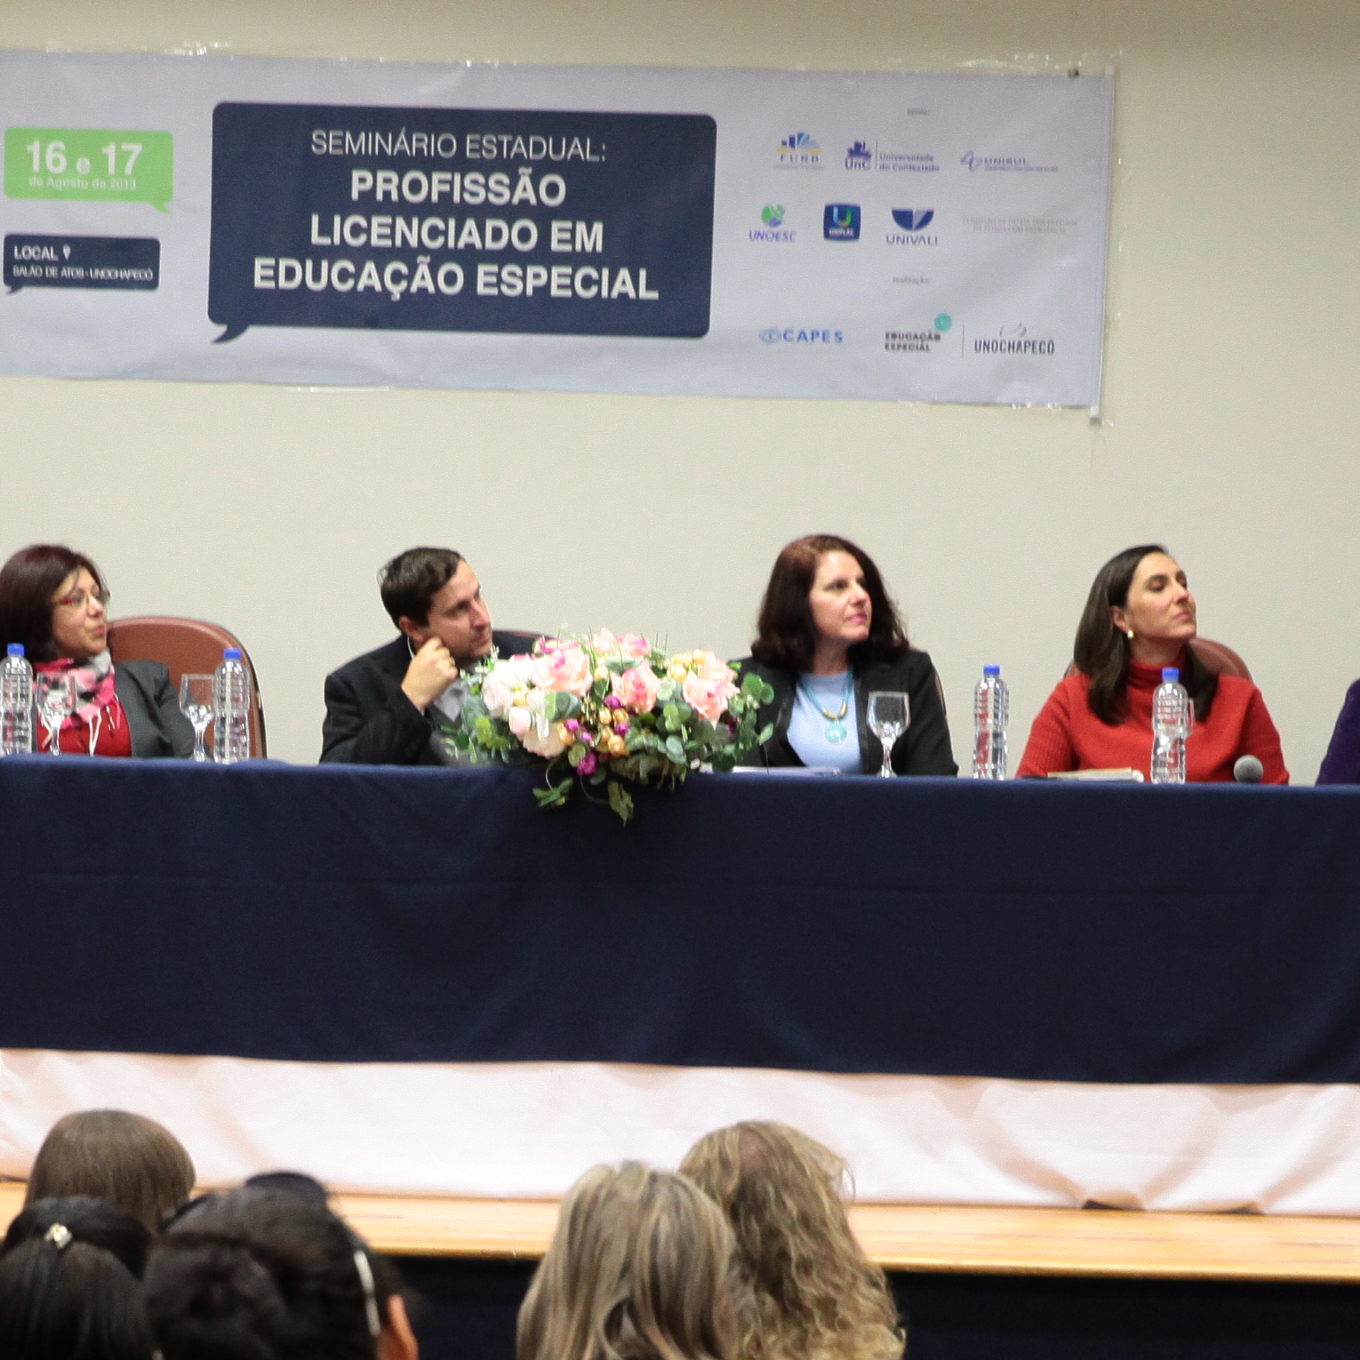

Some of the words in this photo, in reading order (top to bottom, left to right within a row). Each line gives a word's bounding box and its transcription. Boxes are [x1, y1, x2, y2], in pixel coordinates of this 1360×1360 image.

[311, 126, 457, 159] SEMINÁRIO
[466, 133, 606, 162] ESTADUAL:
[26, 139, 67, 174] 16
[76, 157, 90, 175] e
[101, 142, 143, 176] 17
[28, 176, 44, 188] de
[47, 176, 89, 190] Agosto
[91, 178, 107, 189] de
[109, 178, 137, 191] 2013
[351, 166, 566, 207] PROFISSÃO
[310, 213, 538, 252] LICENCIADO
[550, 219, 603, 253] EM
[748, 229, 797, 243] UNOESC
[885, 234, 939, 247] UNIVALI
[13, 244, 59, 261] LOCAL
[45, 265, 58, 280] DE
[254, 254, 465, 302] EDUCAÇÃO
[476, 263, 659, 301] ESPECIAL
[783, 328, 845, 344] CAPES
[884, 342, 931, 353] ESPECIAL
[973, 337, 1056, 356] UNOCHAPECÓ
